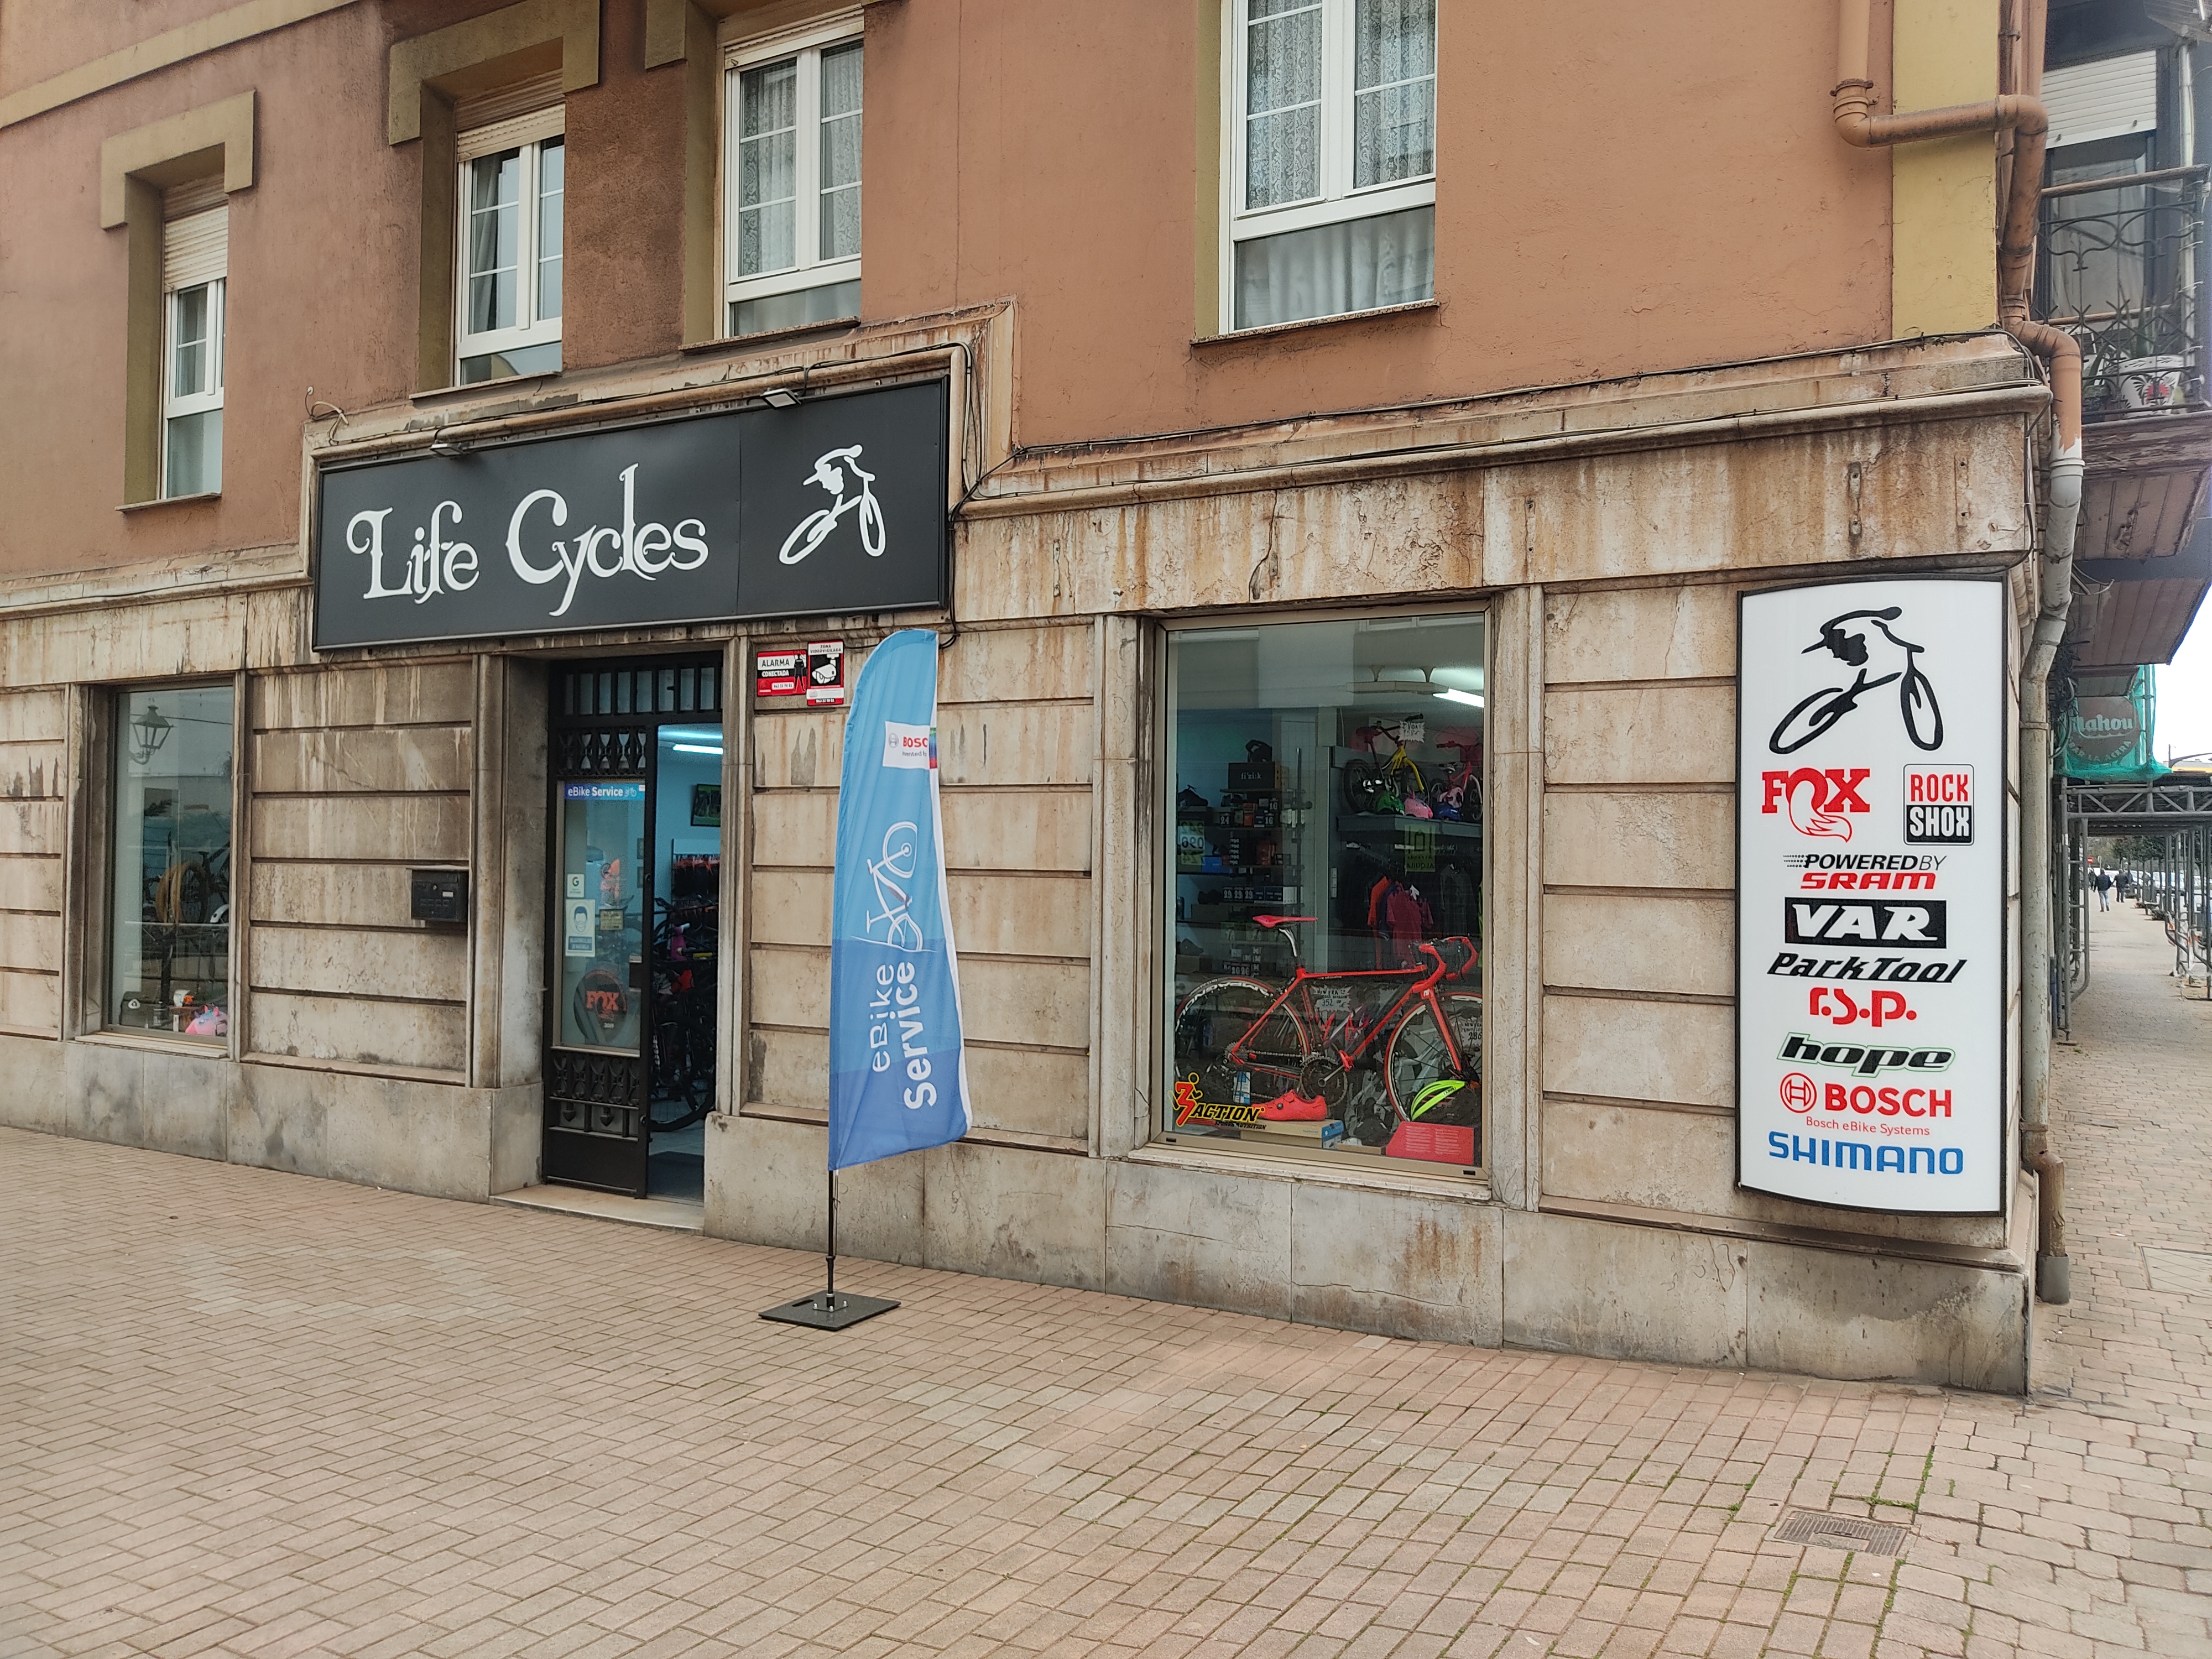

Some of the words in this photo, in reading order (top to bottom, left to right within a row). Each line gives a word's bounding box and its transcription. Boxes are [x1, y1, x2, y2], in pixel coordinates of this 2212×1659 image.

[346, 499, 479, 604] Life
[505, 463, 708, 617] Cycles
[761, 659, 790, 667] ALARMA
[903, 736, 928, 748] BOSC
[568, 786, 590, 796] eBike
[592, 786, 623, 796] Service
[1910, 774, 1968, 802] ROCK
[1220, 816, 1229, 825] 24
[1762, 768, 1870, 843] FOX
[1910, 807, 1969, 837] SHOX
[1801, 873, 1936, 889] SRAM
[1792, 904, 1938, 941] VAR
[586, 990, 619, 1021] FOX
[869, 963, 895, 1072] eBike
[1809, 987, 1917, 1027] r.s.p.
[890, 961, 937, 1109] Service
[1782, 1036, 1952, 1073] hope
[1825, 1082, 1952, 1118] BOSCH
[1806, 1116, 1839, 1130] Bosch
[1843, 1120, 1876, 1134] eBike
[1880, 1123, 1930, 1136] Systems
[1768, 1131, 1963, 1175] SHIMANO
